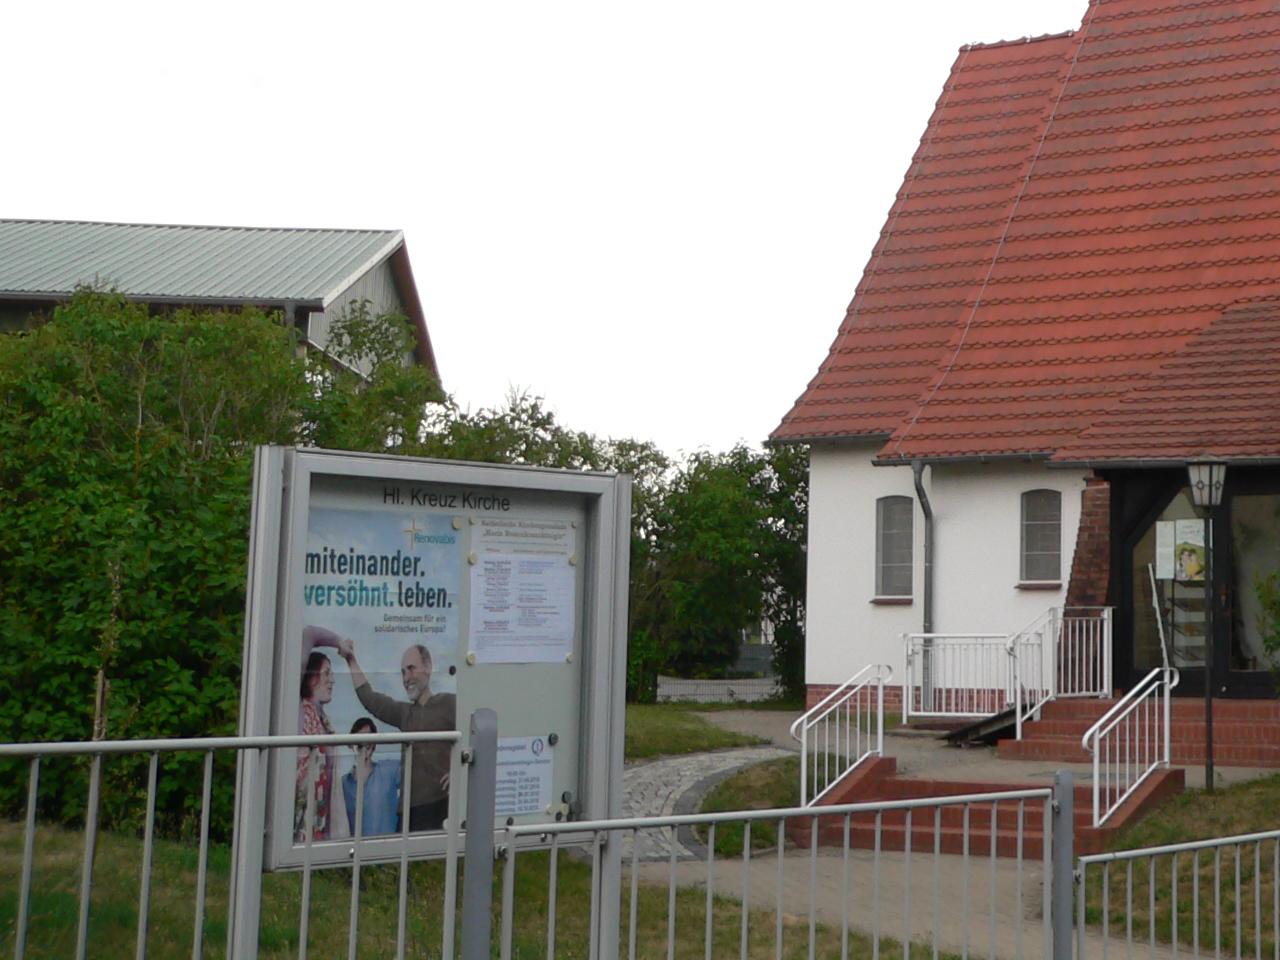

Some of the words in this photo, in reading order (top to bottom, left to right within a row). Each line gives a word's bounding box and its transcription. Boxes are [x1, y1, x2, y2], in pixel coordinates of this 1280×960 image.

[383, 488, 404, 505] Hl.
[411, 488, 457, 508] Kreuz
[462, 491, 511, 512] Kirche
[415, 533, 456, 544] Renovabis
[304, 546, 426, 577] miteinander.
[303, 579, 394, 607] versöhnt.
[398, 581, 452, 609] leben.
[383, 613, 423, 622] Gemeinsam
[424, 614, 434, 623] für
[436, 615, 446, 623] ein
[374, 624, 418, 633] solidarisches
